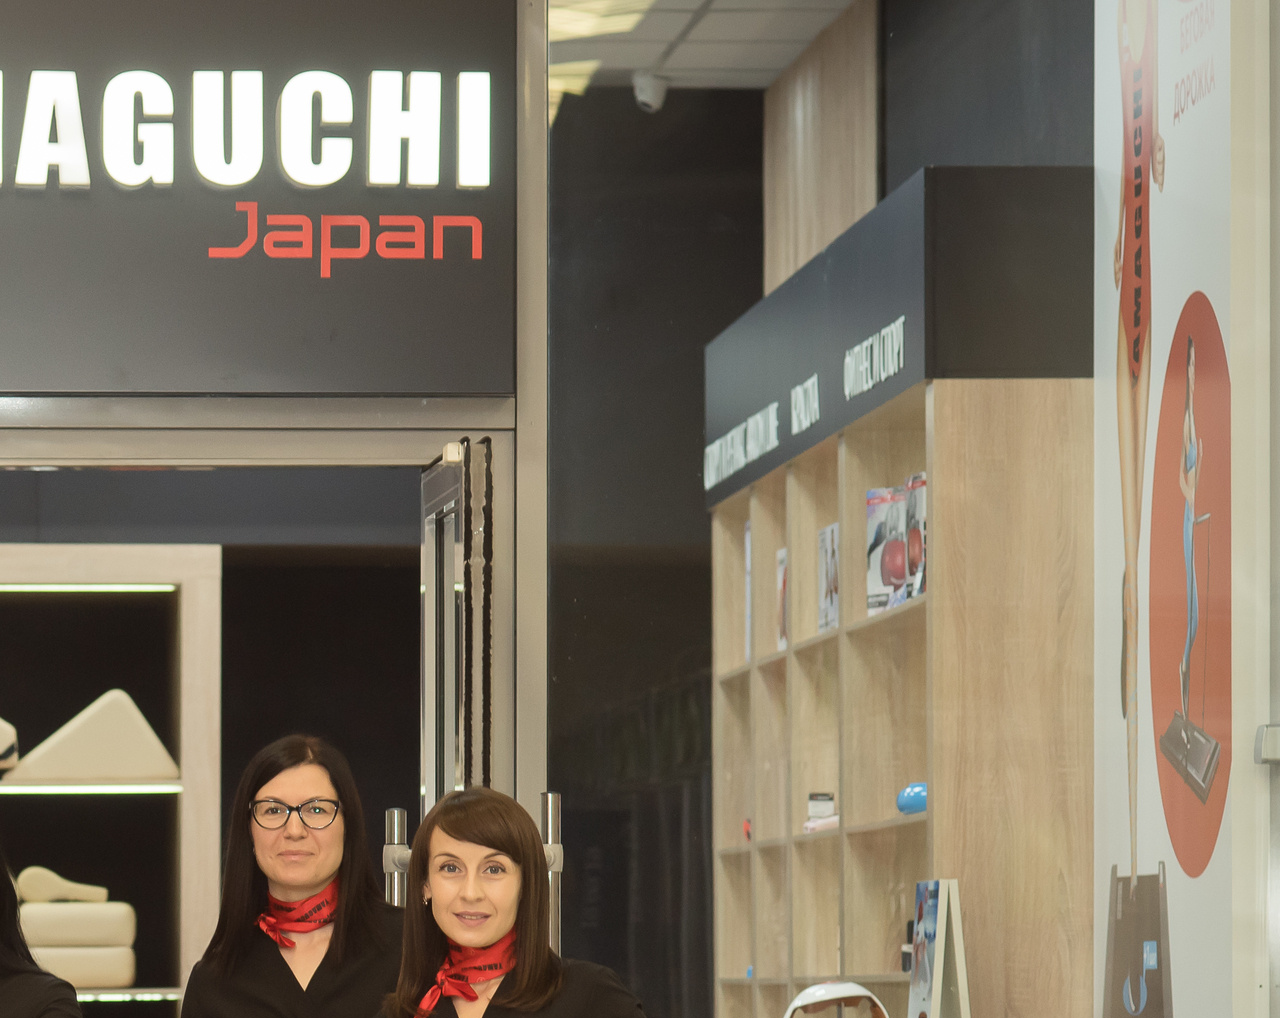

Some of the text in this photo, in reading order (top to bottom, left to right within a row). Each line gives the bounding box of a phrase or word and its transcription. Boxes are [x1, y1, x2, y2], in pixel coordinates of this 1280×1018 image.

[1173, 54, 1216, 127] ДОРОЖКА
[208, 202, 483, 278] Japan
[1131, 67, 1142, 393] YAMAGUCHI
